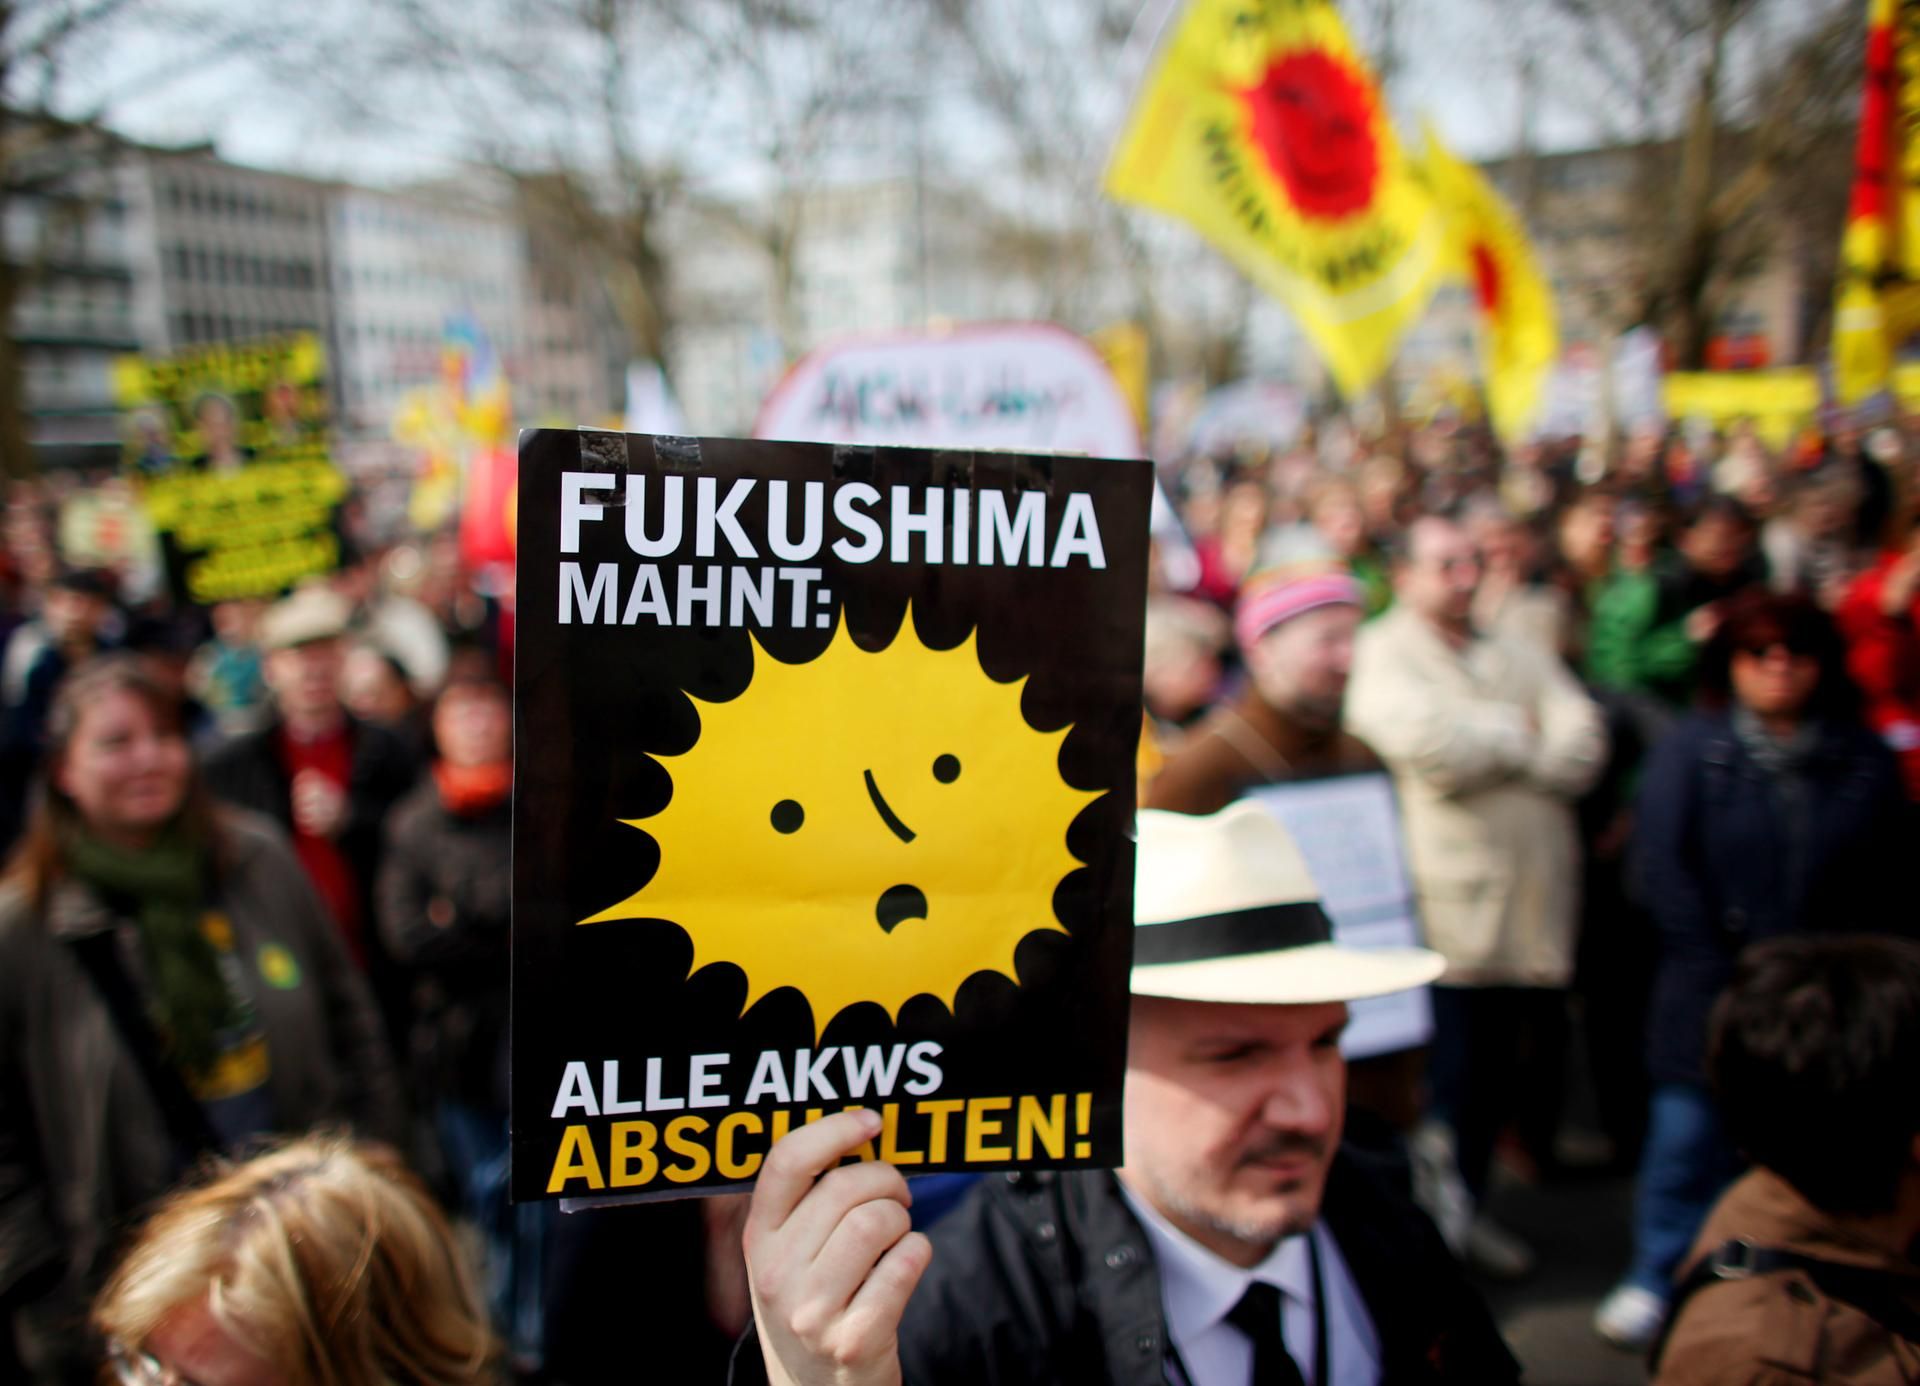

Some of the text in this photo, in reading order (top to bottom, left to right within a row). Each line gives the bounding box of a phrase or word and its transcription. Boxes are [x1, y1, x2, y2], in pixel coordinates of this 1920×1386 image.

[558, 471, 1107, 569] FUKUSHIMA
[558, 561, 832, 628] MAHNT:
[550, 1041, 944, 1118] ALLE AKWS
[545, 1092, 1092, 1193] ABSCLTEN!
